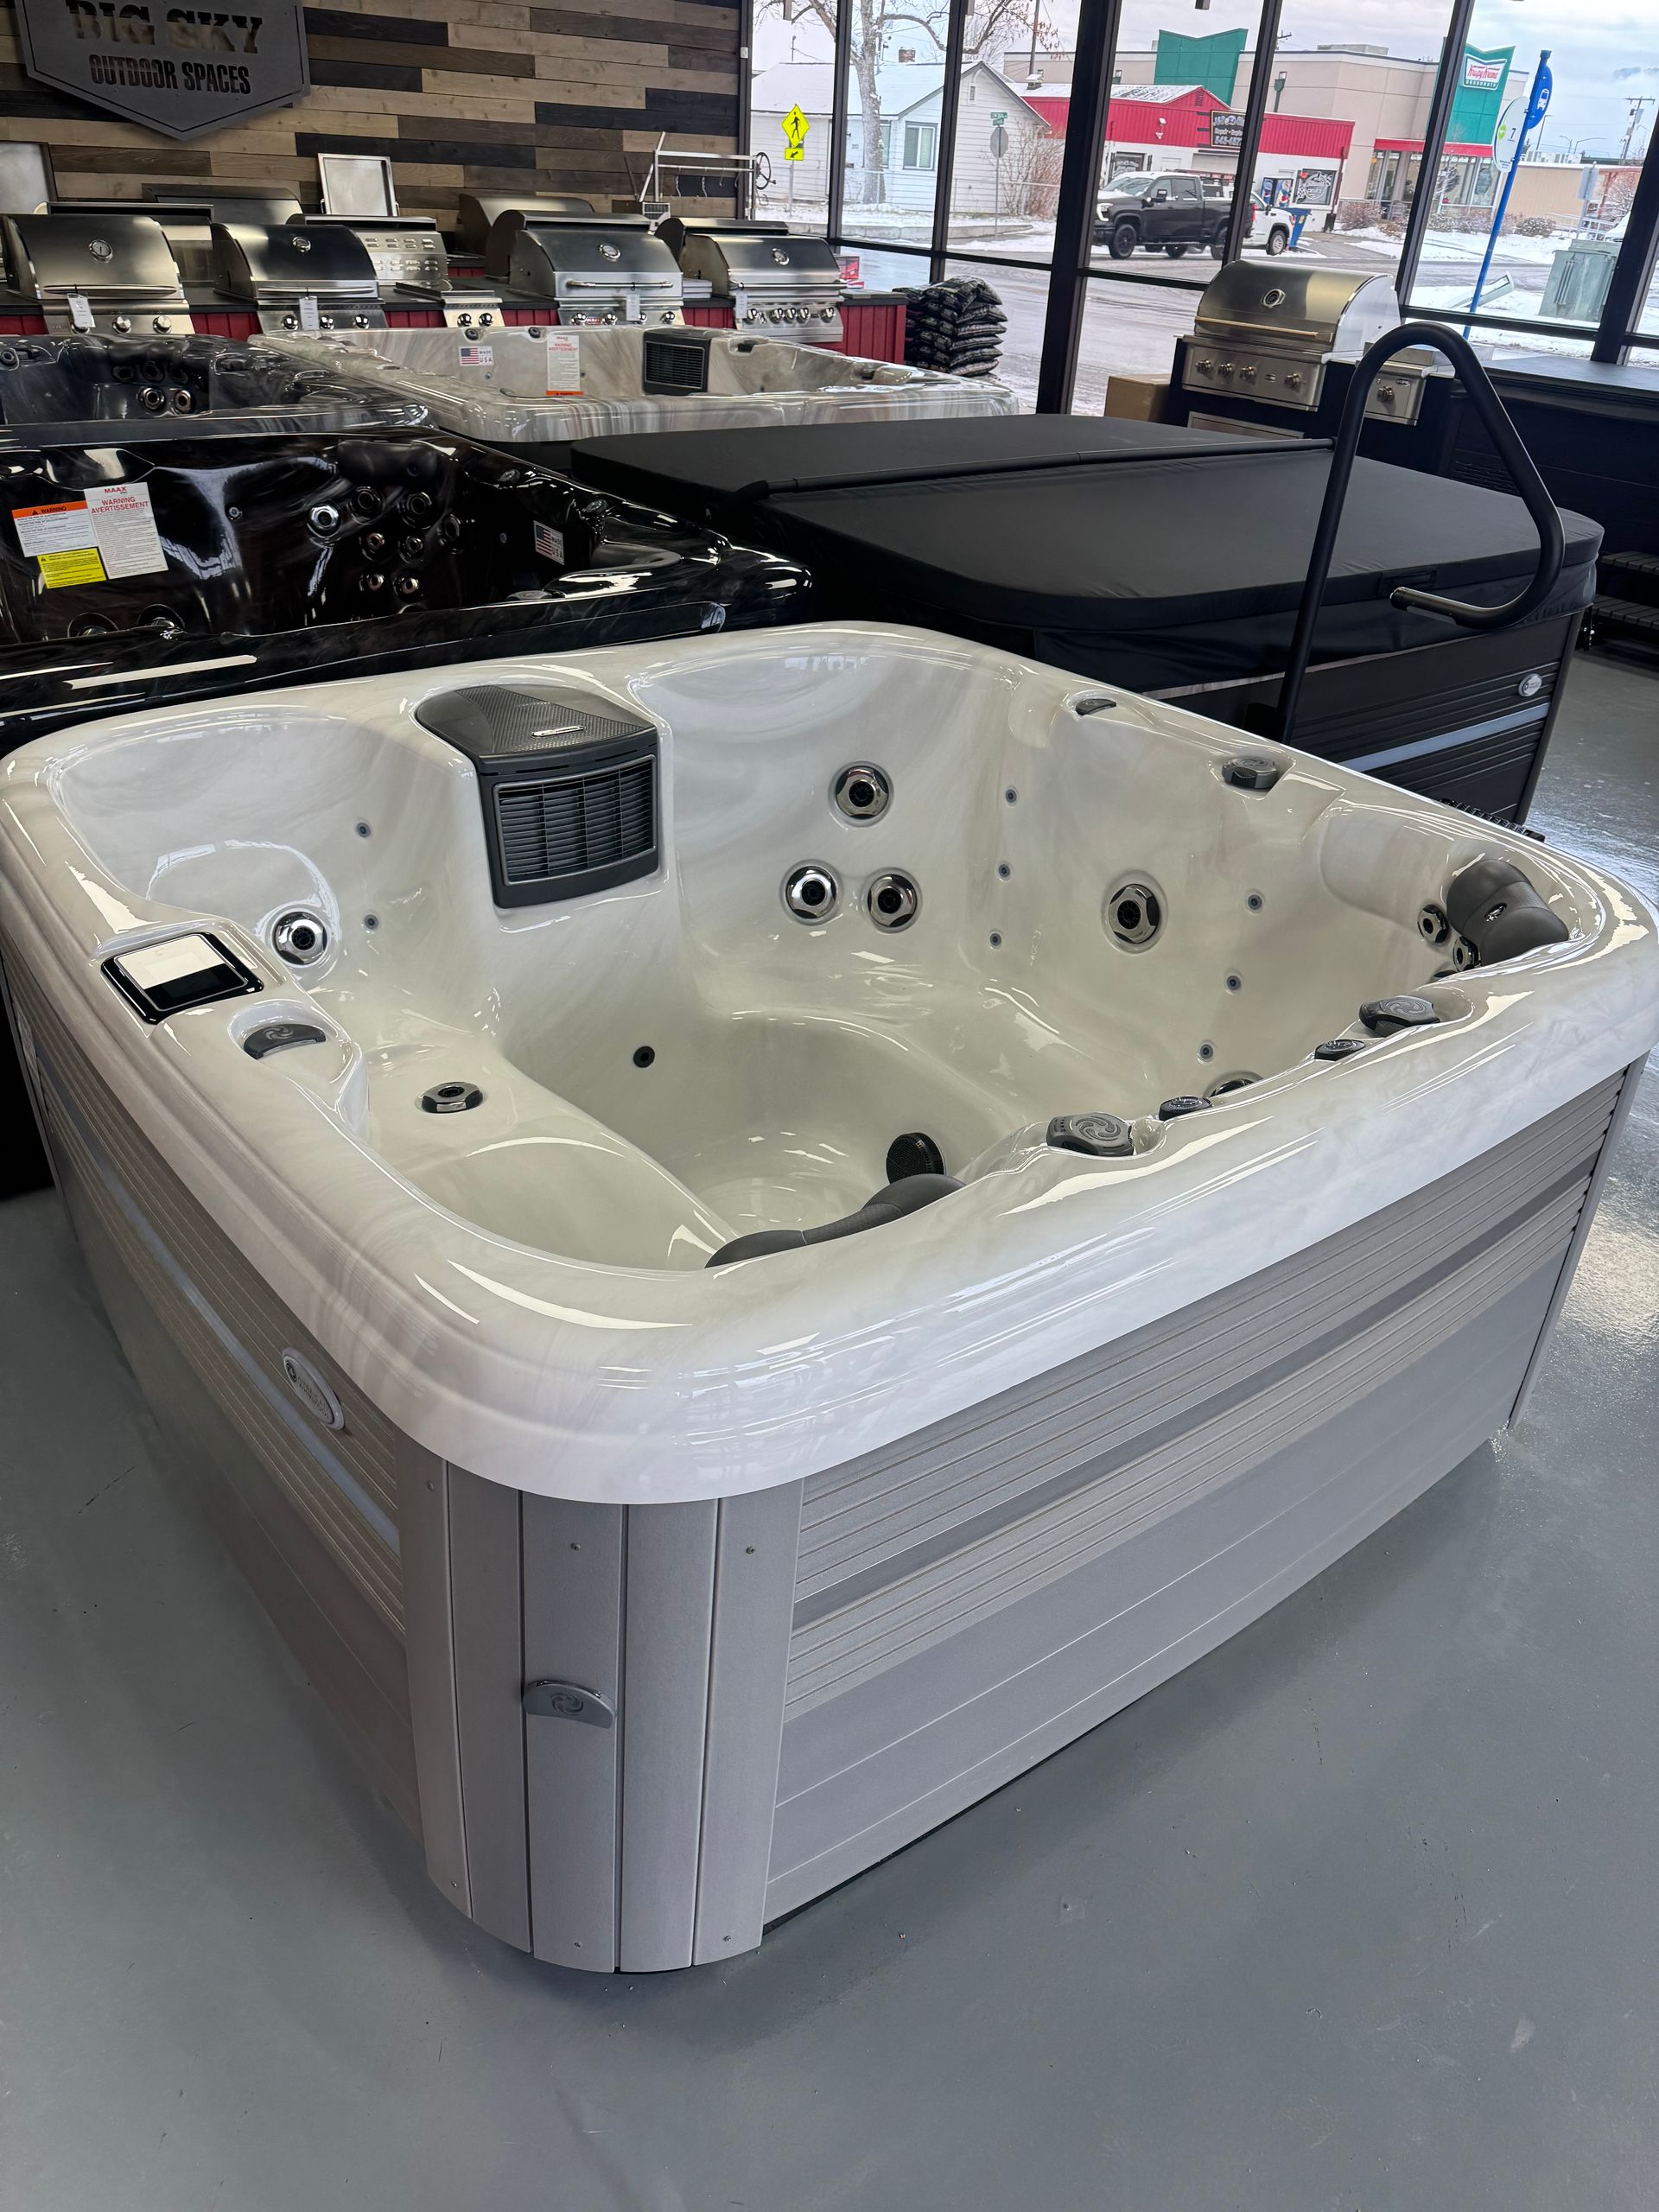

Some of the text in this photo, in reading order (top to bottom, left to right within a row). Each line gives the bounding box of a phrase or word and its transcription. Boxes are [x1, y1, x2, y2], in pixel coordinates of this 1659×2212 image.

[66, 0, 262, 54] BIG SKY
[89, 54, 251, 94] OUTDOOR SPACES
[1510, 128, 1516, 138] 7
[102, 496, 136, 506] WARNING
[41, 505, 67, 514] WARNING
[91, 501, 149, 514] AVERTISSEMENT
